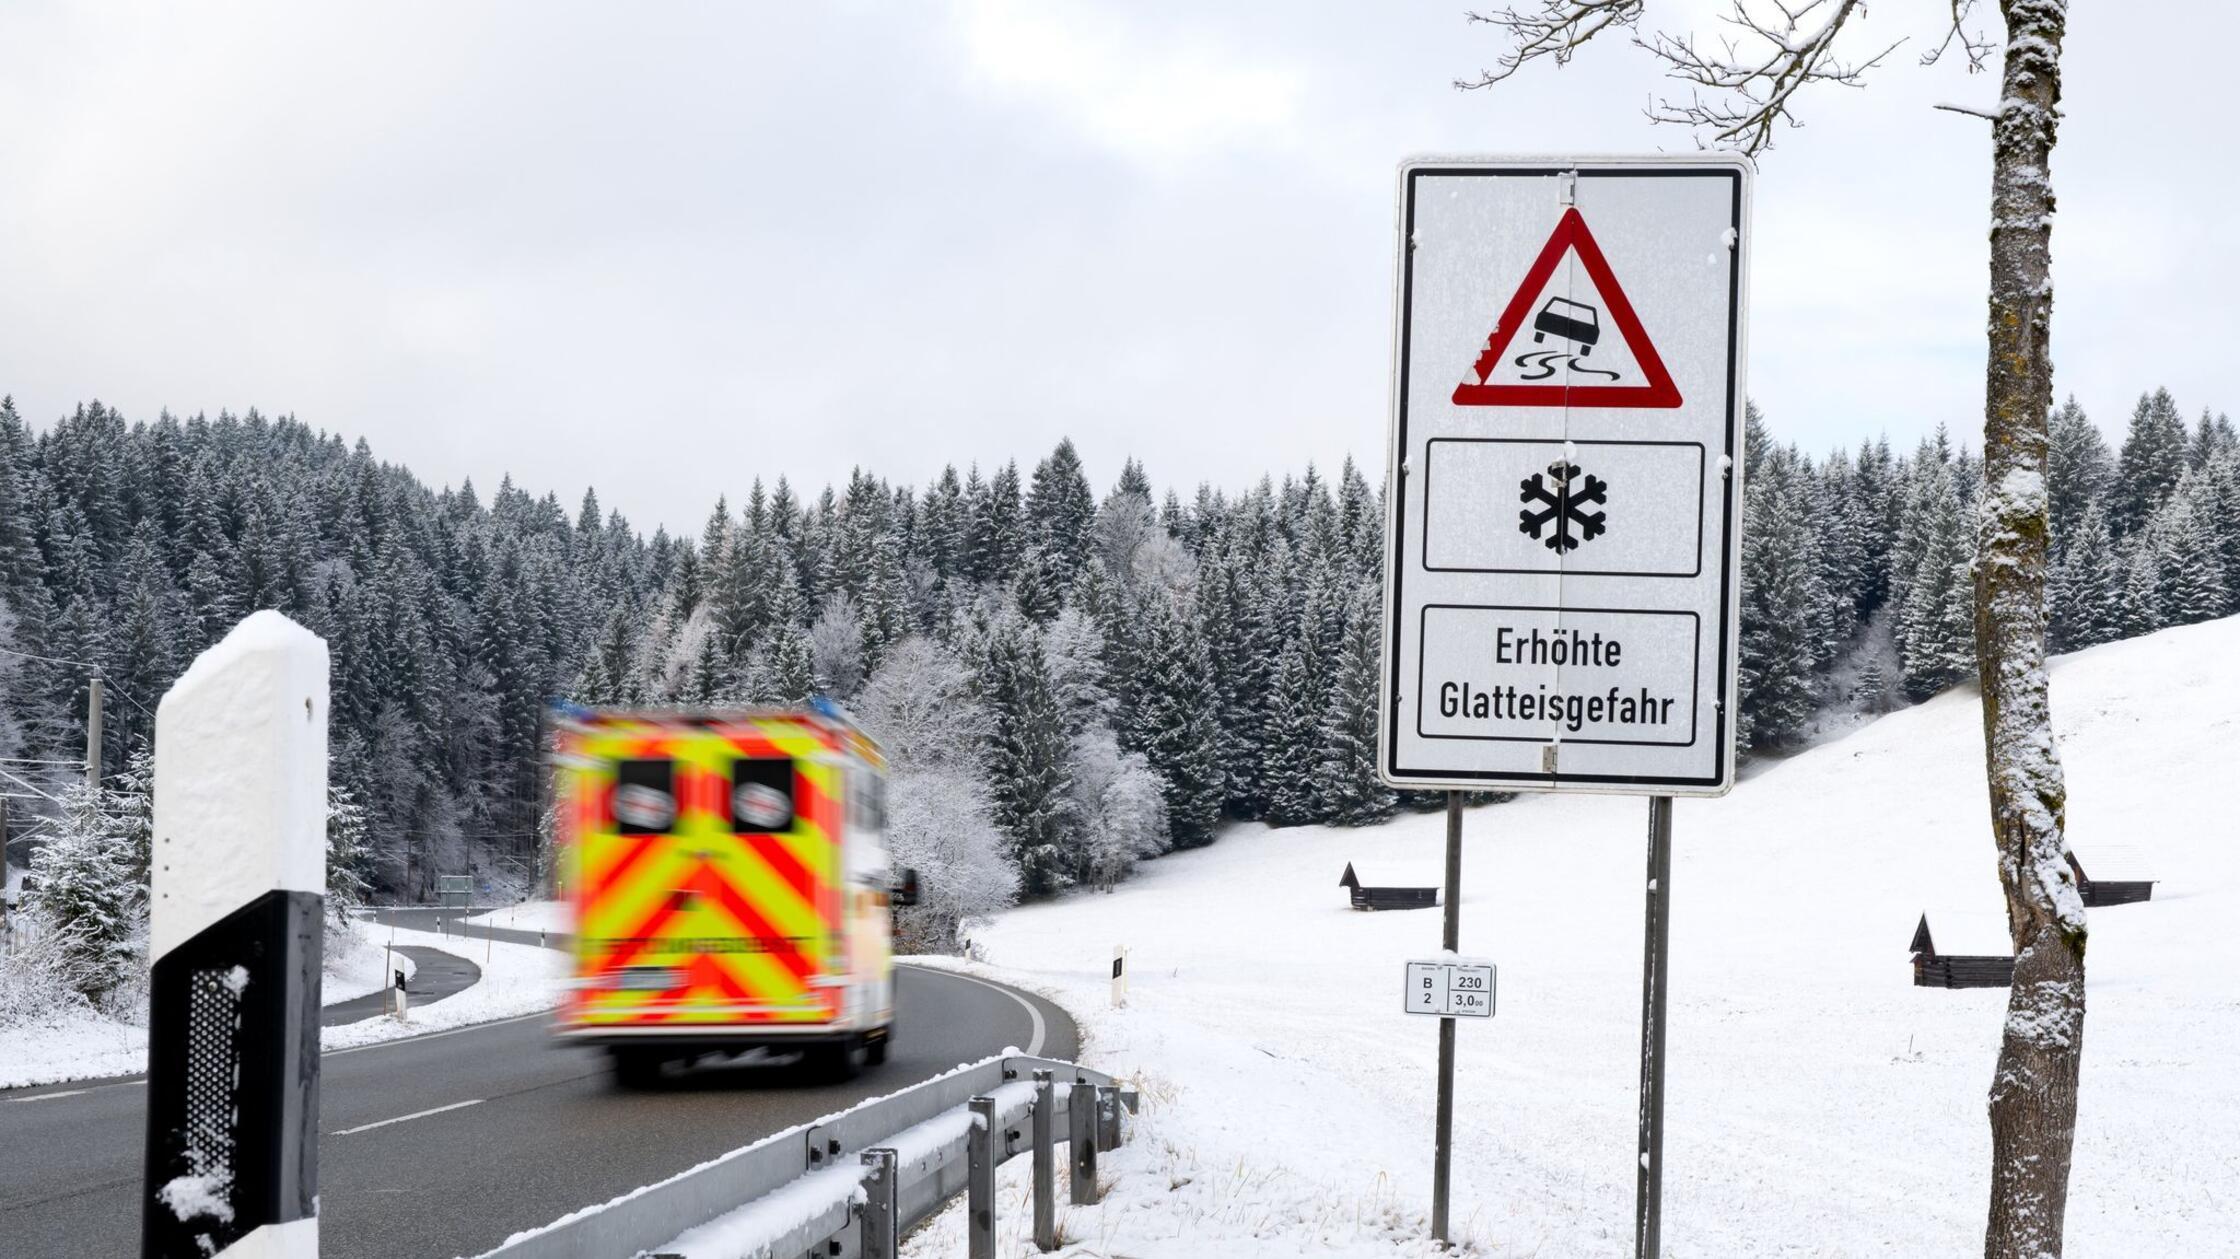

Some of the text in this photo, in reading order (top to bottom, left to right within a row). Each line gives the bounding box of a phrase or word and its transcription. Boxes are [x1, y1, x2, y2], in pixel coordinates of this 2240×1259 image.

[1496, 627, 1622, 667] Erhöhte
[1440, 681, 1675, 732] Glatteisgefahr
[1423, 977, 1433, 988] B
[1459, 977, 1482, 989] 230
[1424, 993, 1432, 1004] 2
